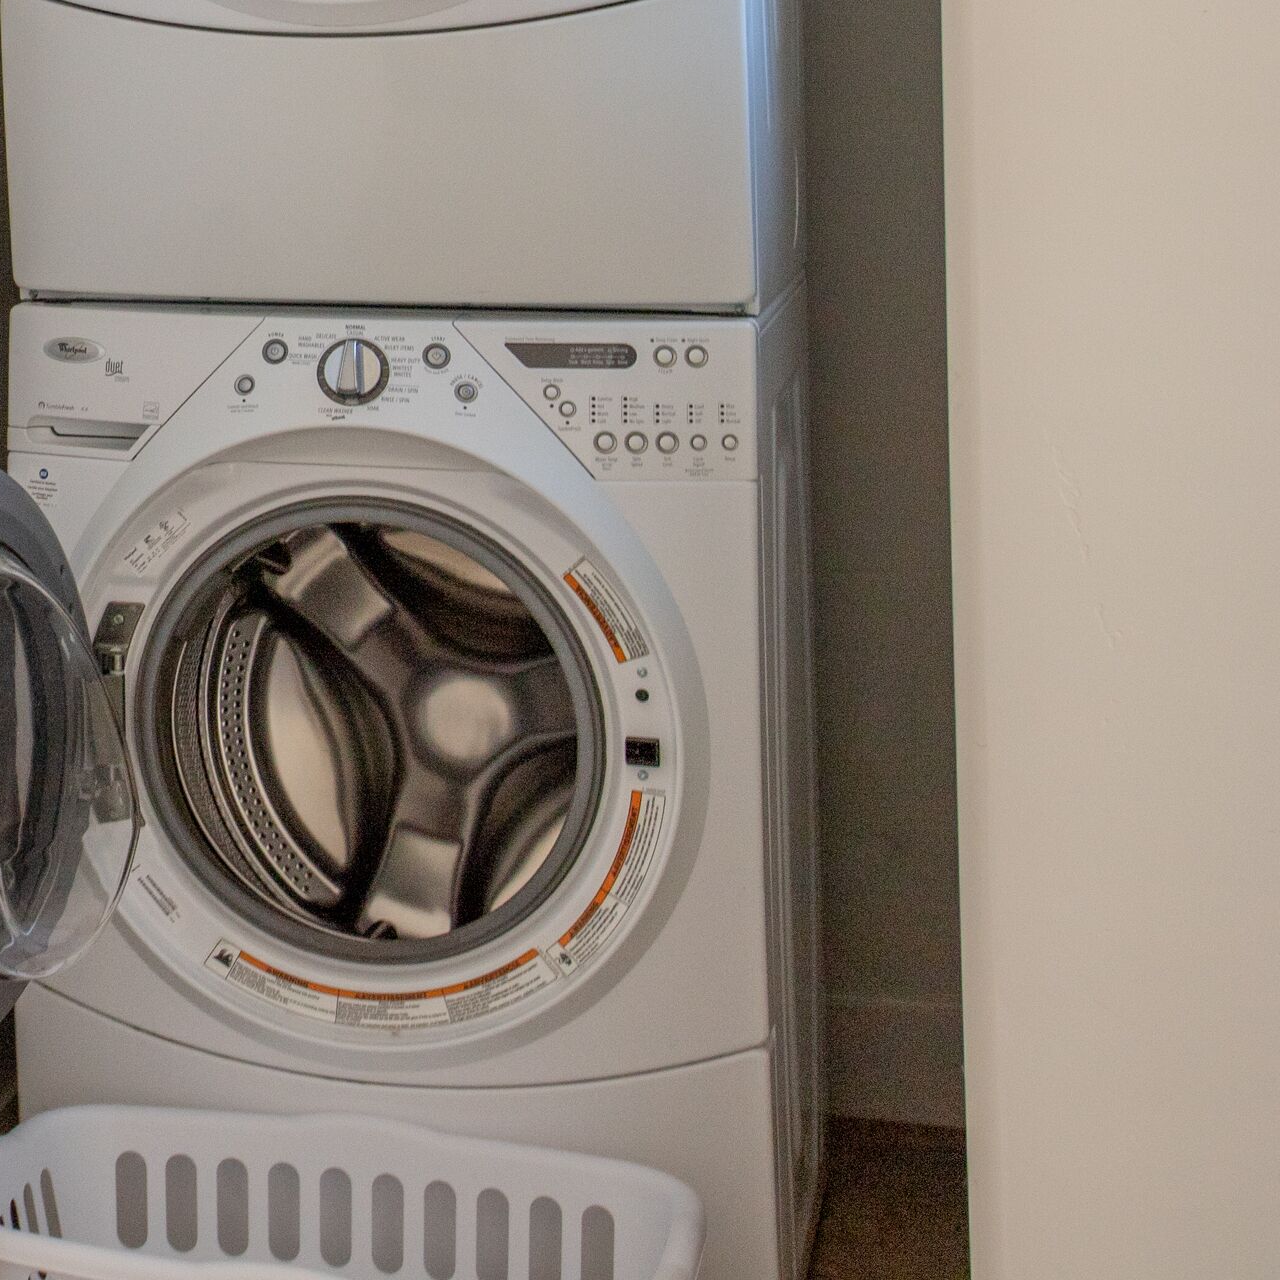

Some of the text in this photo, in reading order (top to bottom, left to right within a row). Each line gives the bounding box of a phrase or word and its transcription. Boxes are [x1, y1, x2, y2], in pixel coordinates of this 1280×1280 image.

[315, 332, 337, 340] DELICATE
[57, 341, 88, 355] Whirlpool
[105, 357, 124, 377] duet
